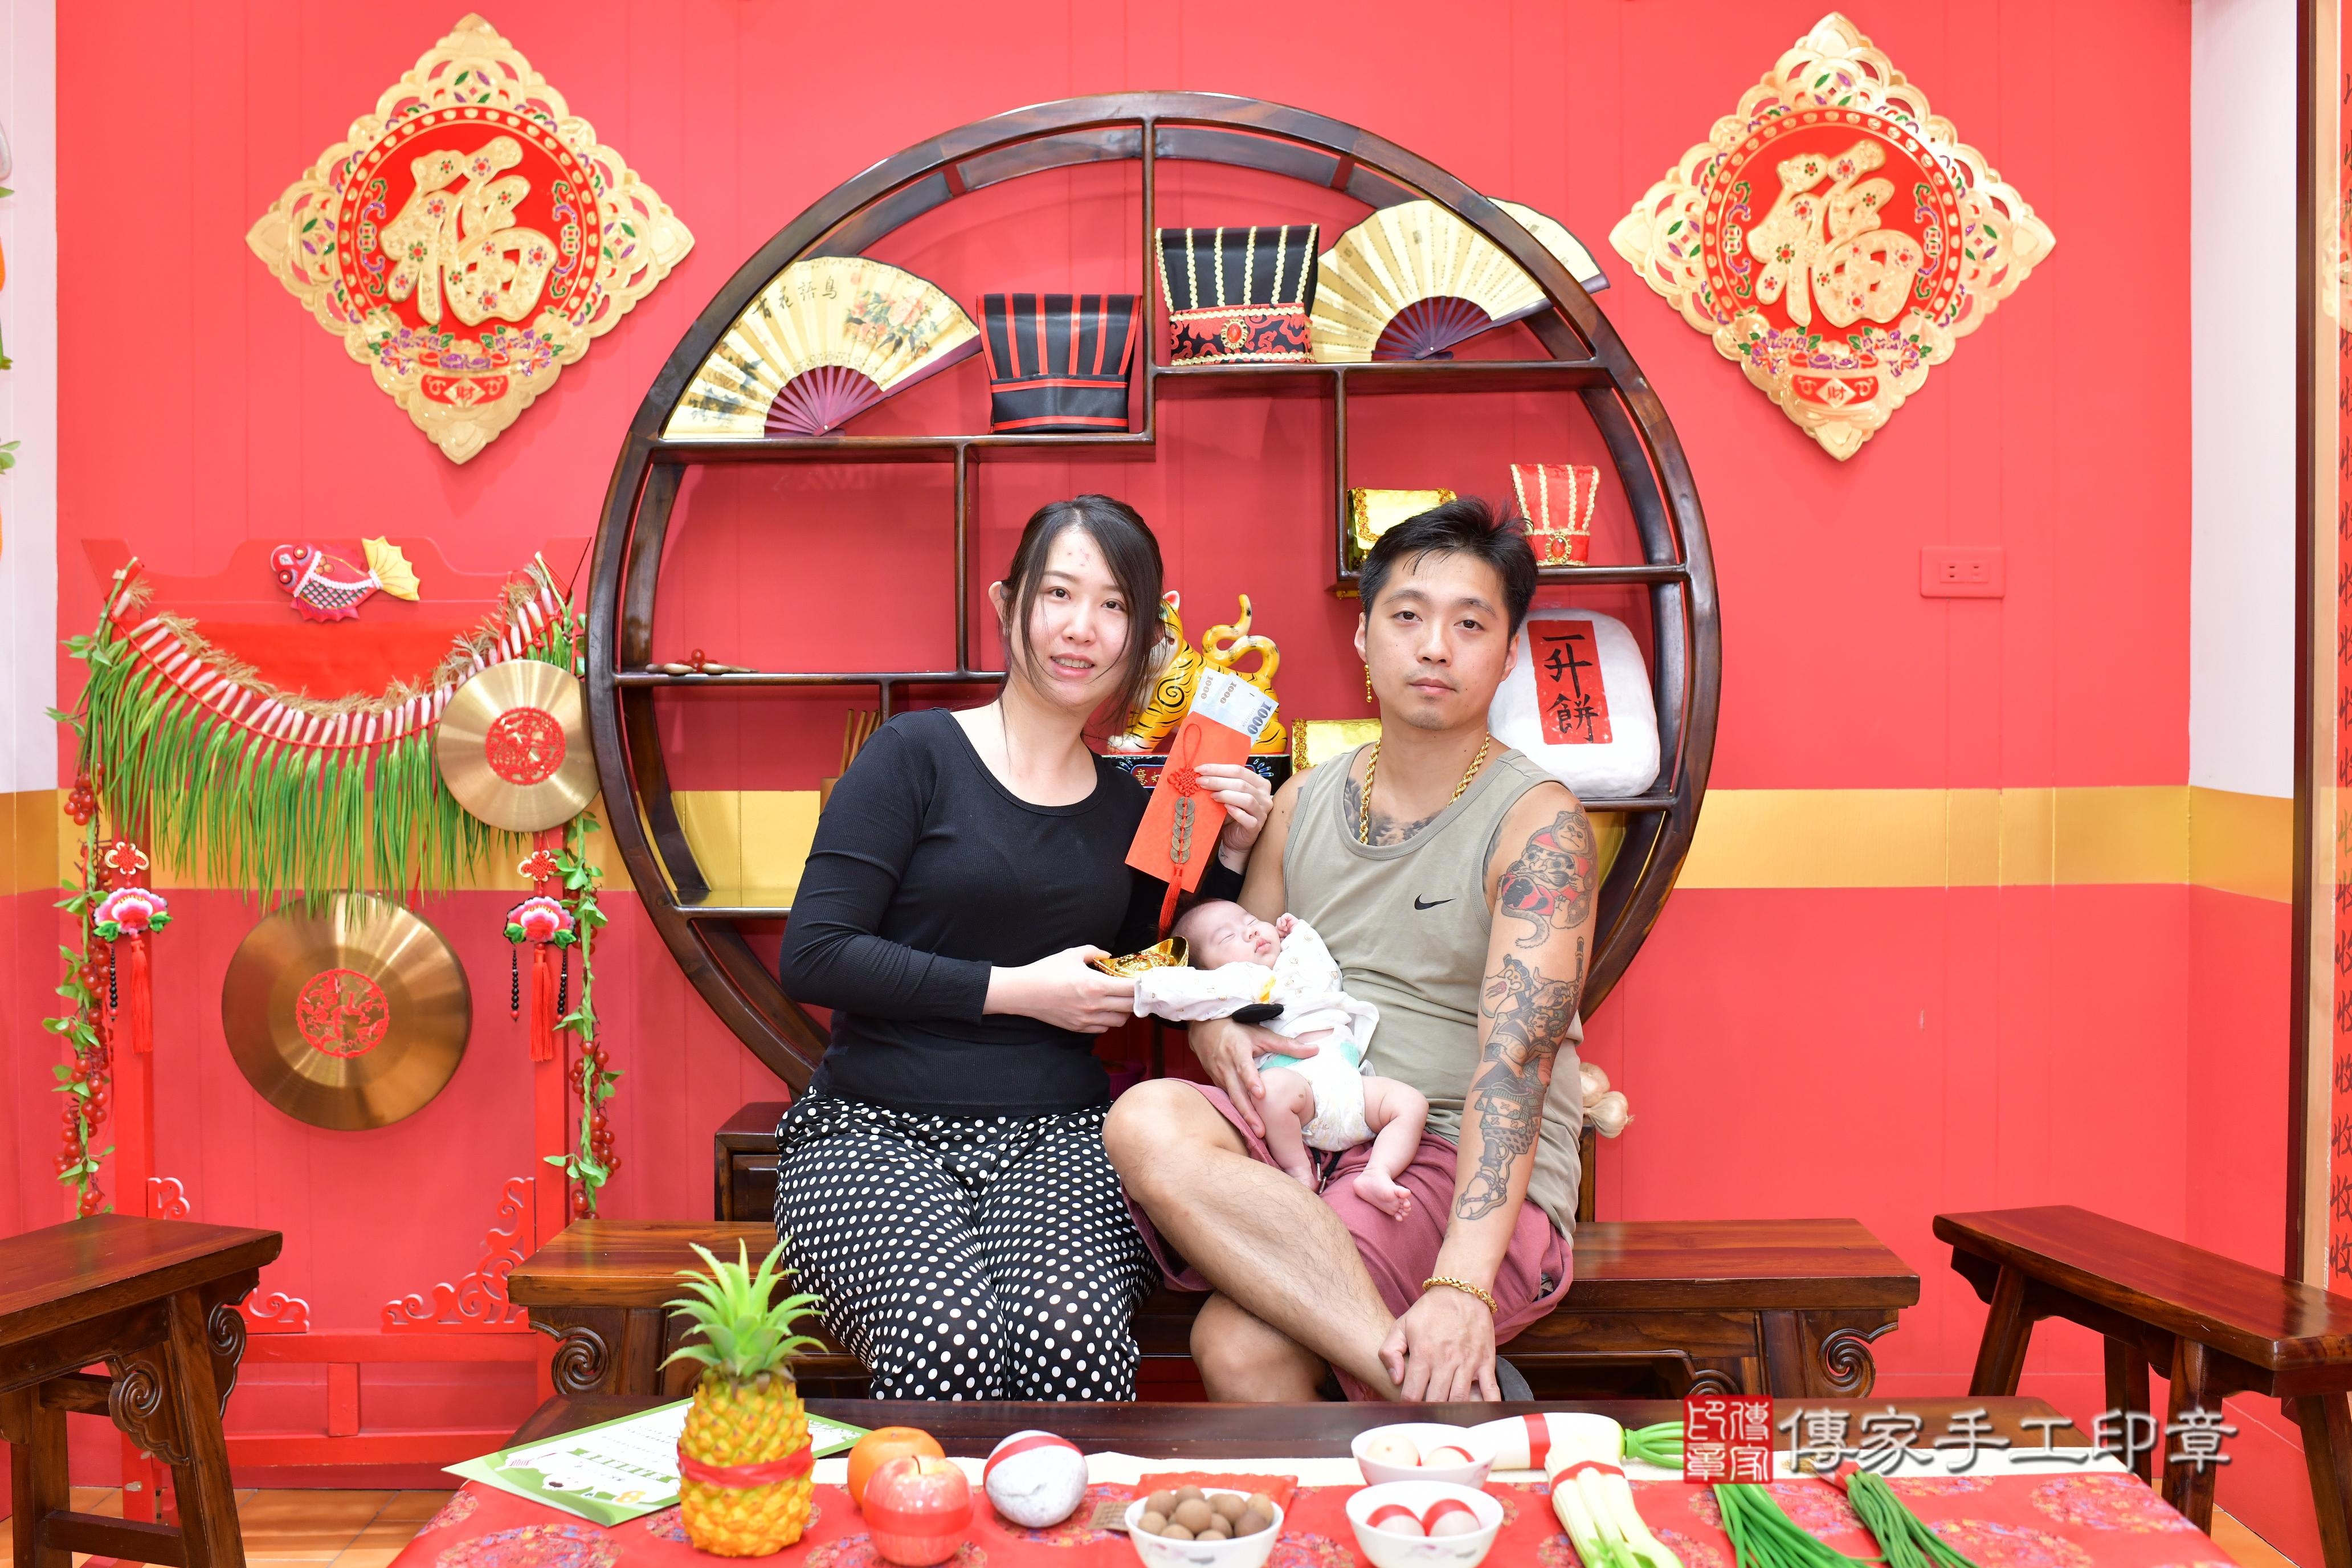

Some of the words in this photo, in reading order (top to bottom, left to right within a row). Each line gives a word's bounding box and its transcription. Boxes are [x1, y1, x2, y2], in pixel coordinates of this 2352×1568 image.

[378, 135, 558, 327] 福
[1747, 138, 1925, 329] 福
[1200, 675, 1214, 700] 1000
[1220, 681, 1238, 704] 1000
[1247, 701, 1272, 734] 1000
[1541, 634, 1599, 744] 一升餅
